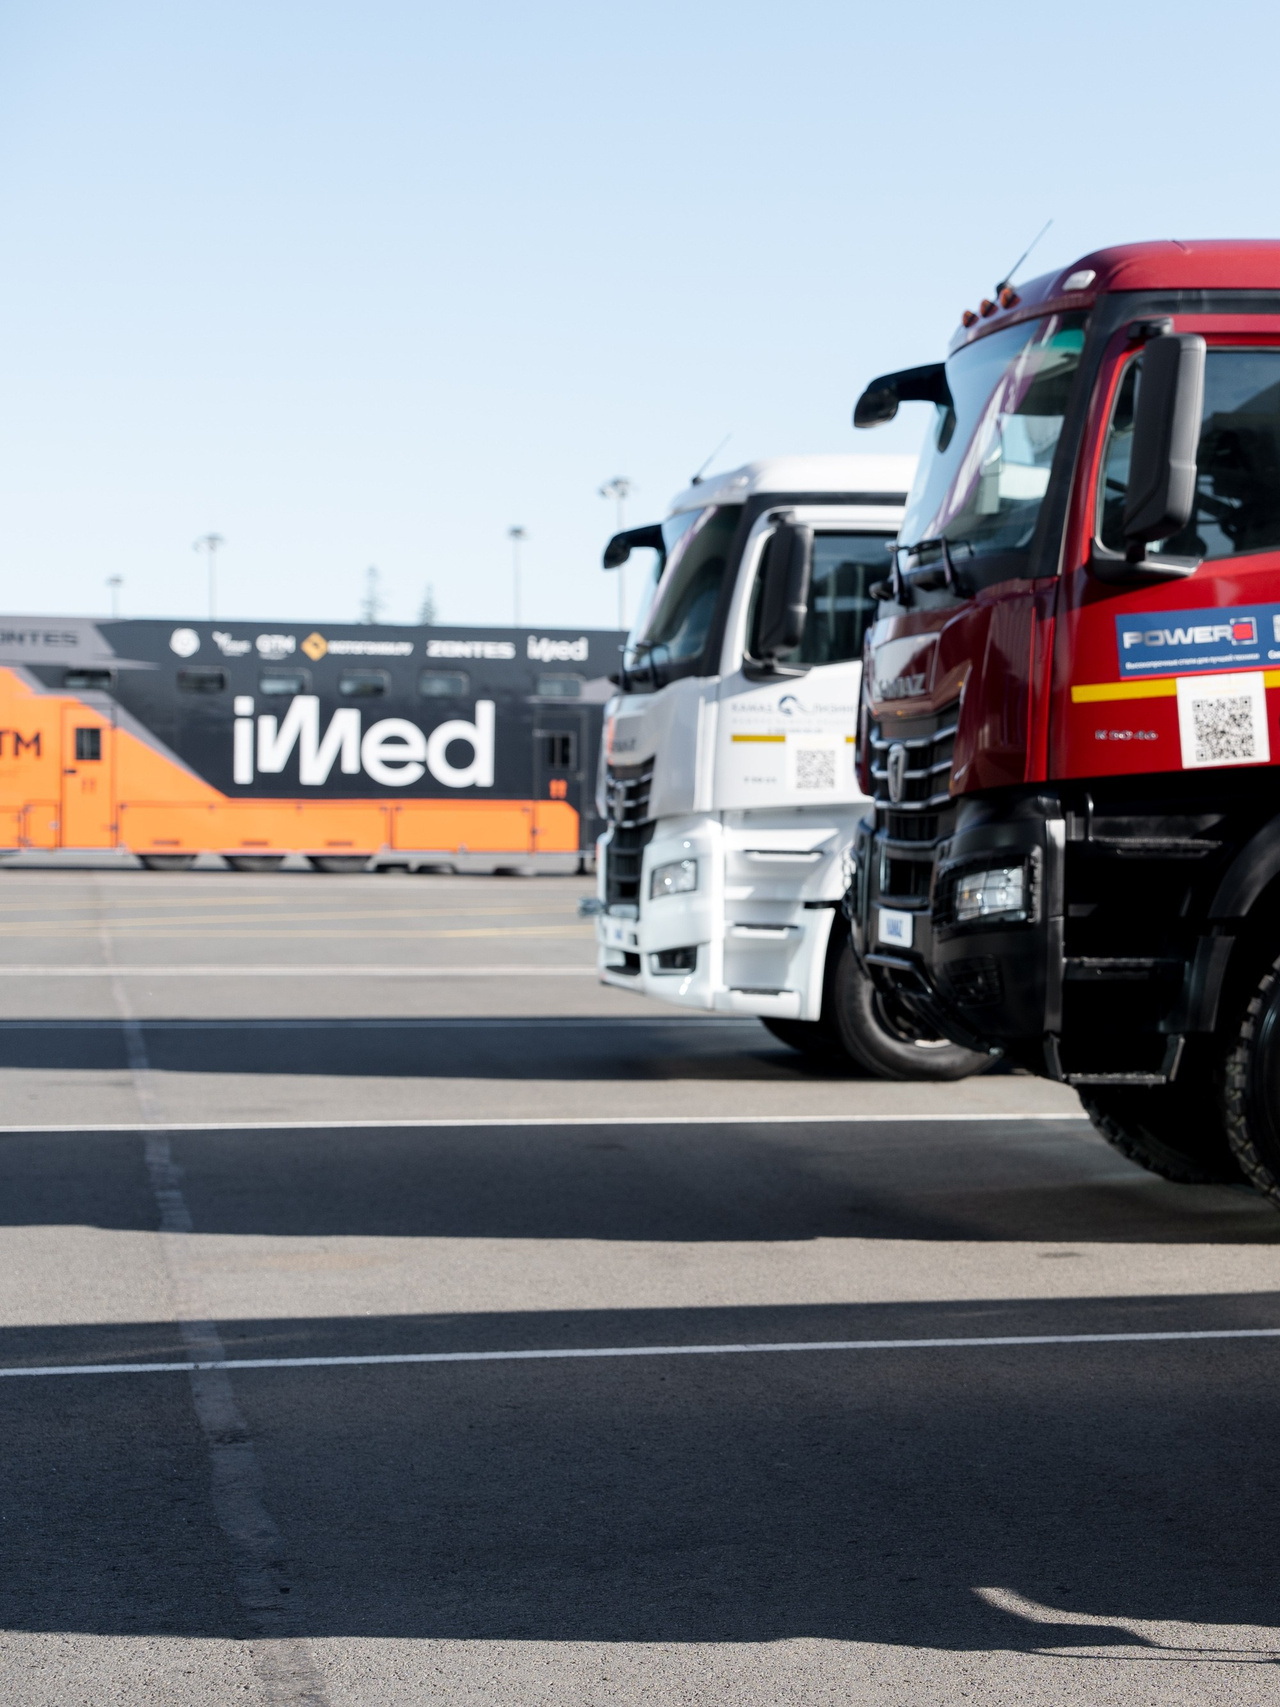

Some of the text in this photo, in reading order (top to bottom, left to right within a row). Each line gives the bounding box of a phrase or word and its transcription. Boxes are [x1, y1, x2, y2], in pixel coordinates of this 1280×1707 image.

[1123, 624, 1231, 649] POWER
[426, 640, 516, 659] ZONTES
[233, 695, 496, 788] iMed
